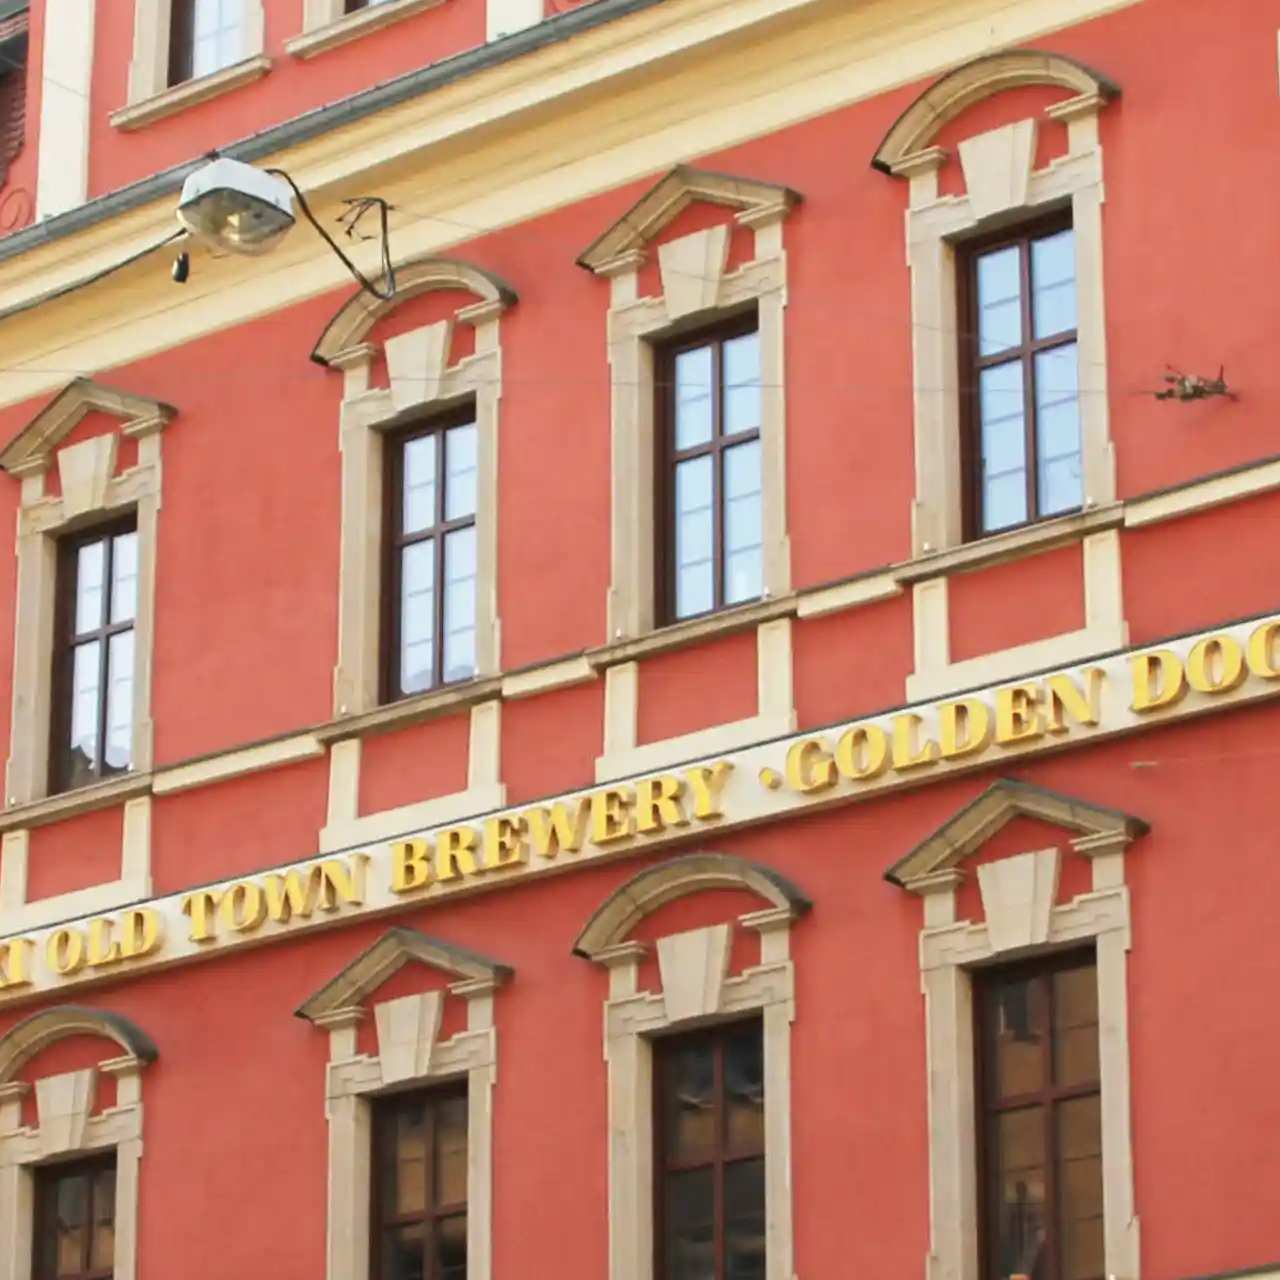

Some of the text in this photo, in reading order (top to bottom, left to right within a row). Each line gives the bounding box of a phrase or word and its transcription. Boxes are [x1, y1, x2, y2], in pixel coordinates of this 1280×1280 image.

[46, 907, 161, 974] OLD
[183, 853, 371, 941] TOWN
[389, 763, 733, 894] BREWERY
[786, 666, 1105, 793] GOLDEN
